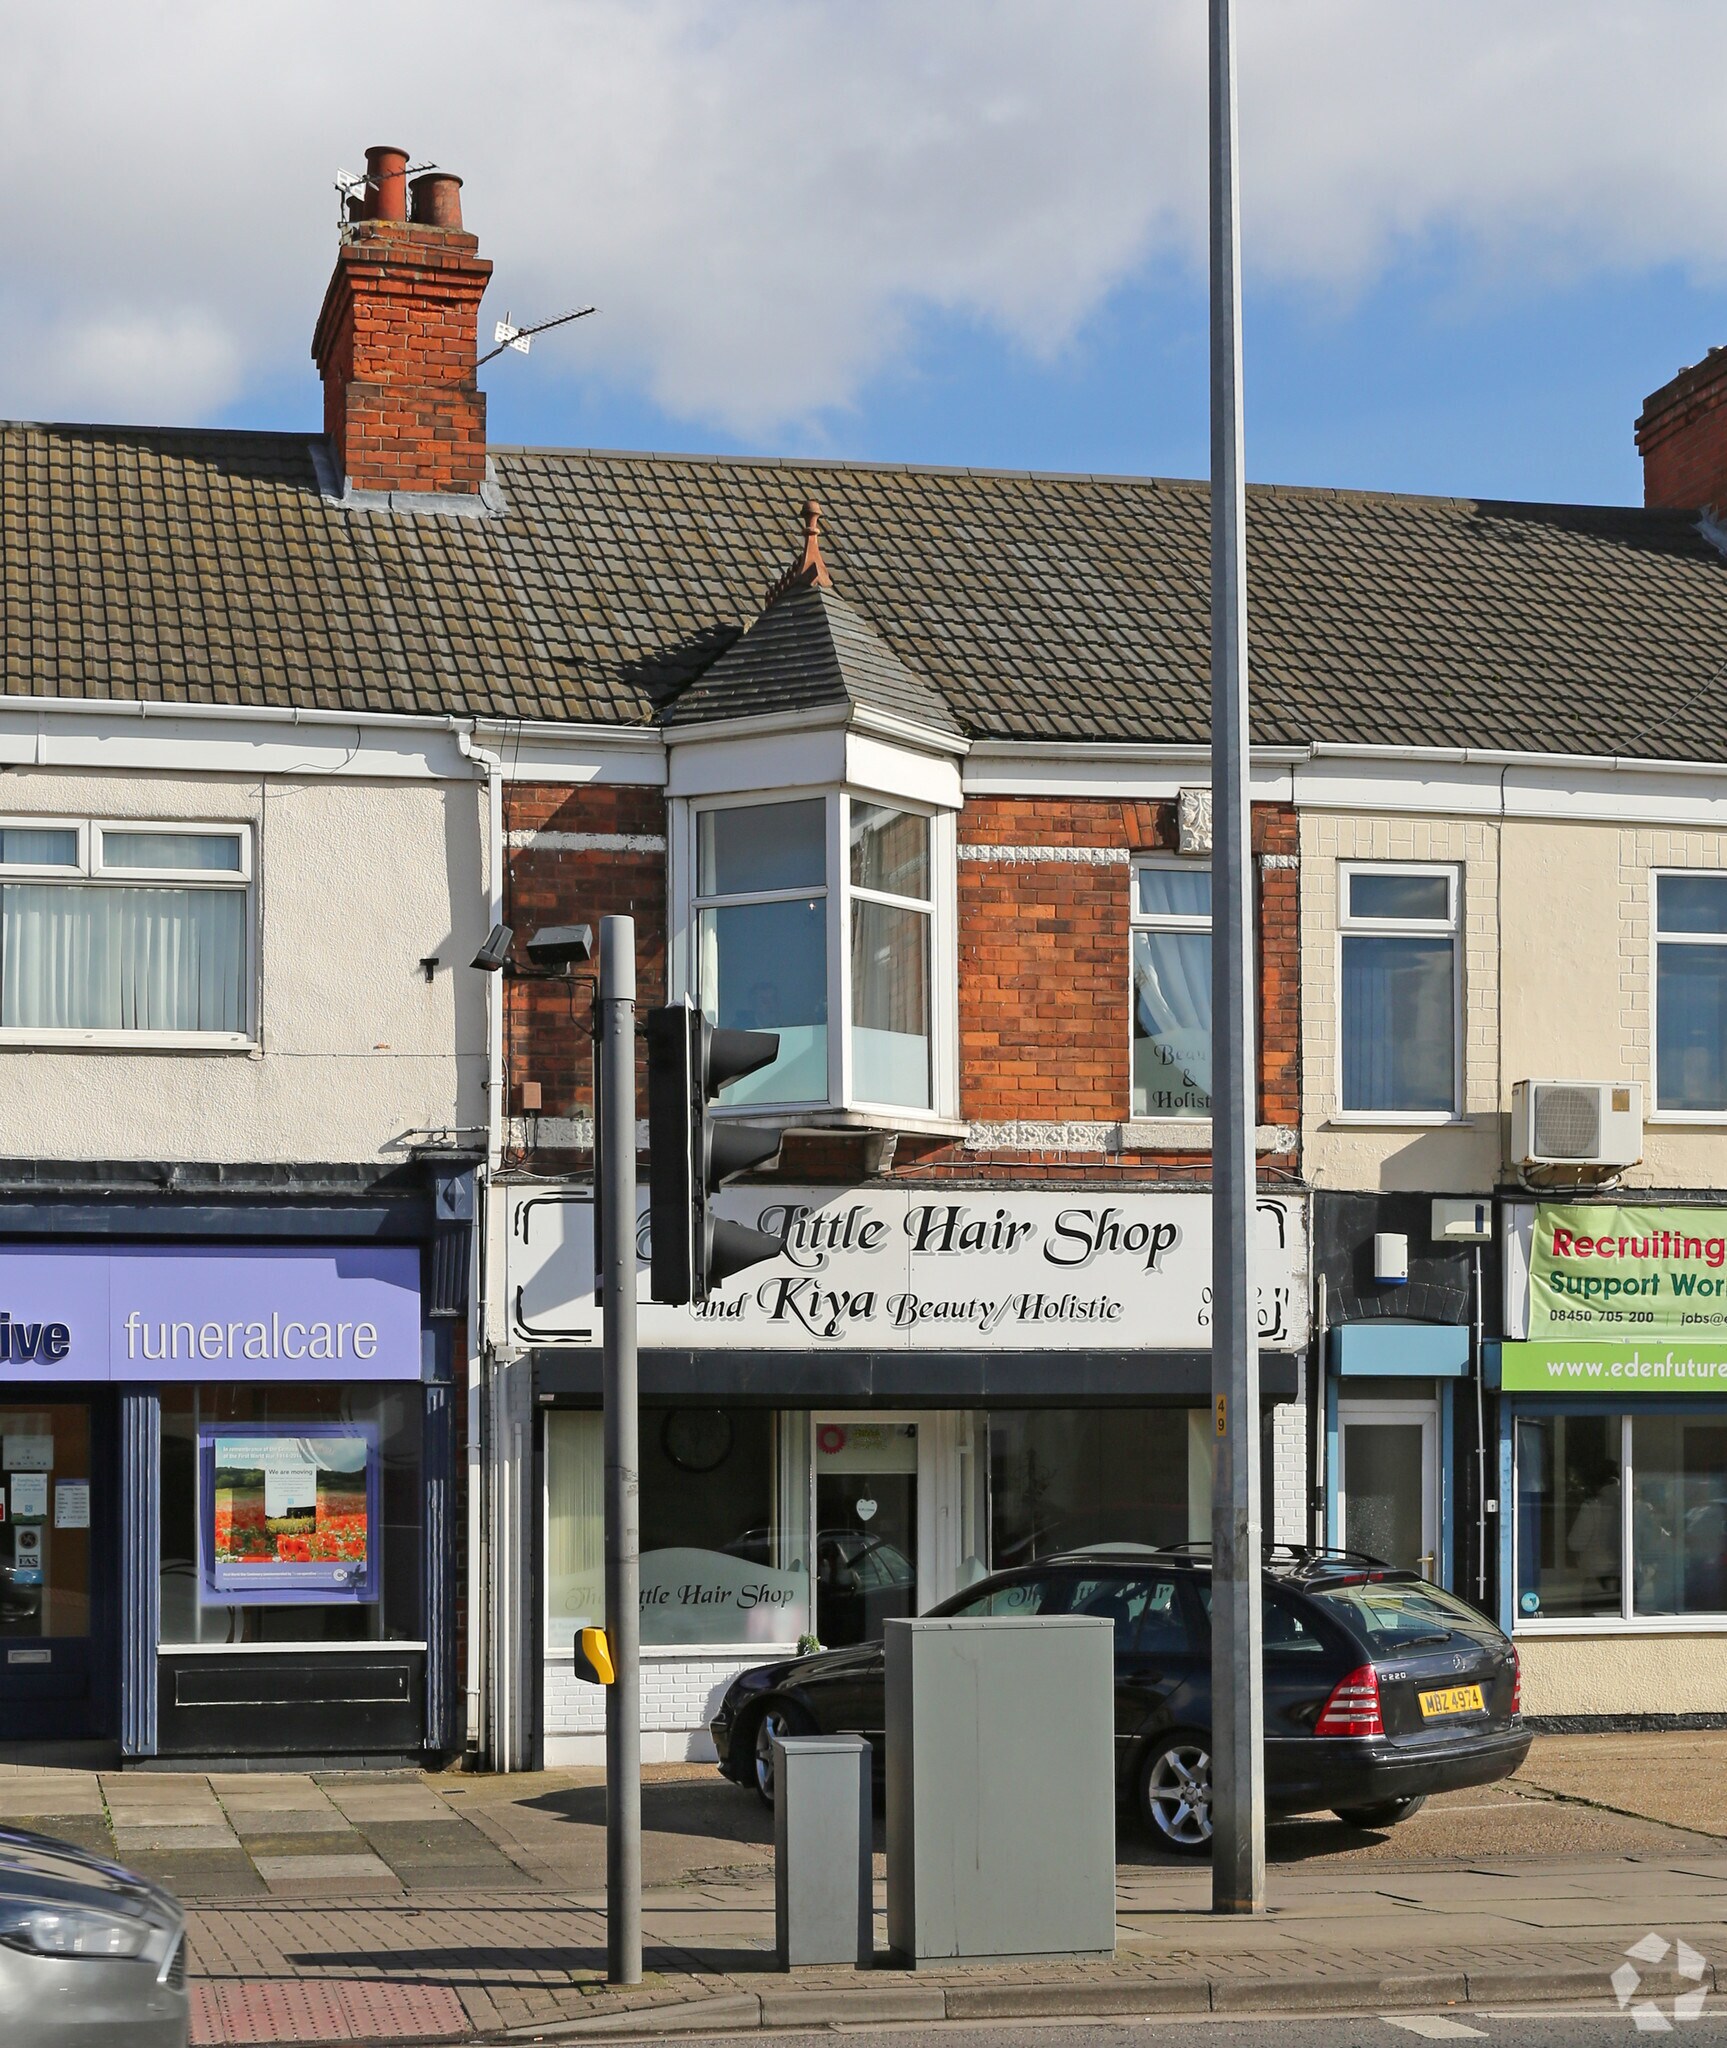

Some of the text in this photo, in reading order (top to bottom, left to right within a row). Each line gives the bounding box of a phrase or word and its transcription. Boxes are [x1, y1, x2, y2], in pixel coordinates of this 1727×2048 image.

[1154, 1044, 1207, 1066] Beau
[1183, 1068, 1198, 1087] &
[1152, 1090, 1211, 1108] Holist
[757, 1204, 888, 1270] Little
[903, 1205, 1035, 1254] Hair
[1043, 1207, 1181, 1273] Shop
[1552, 1228, 1726, 1268] Recruiting
[1550, 1270, 1727, 1300] Support Wor
[696, 1277, 1123, 1338] and Kiya Beauty/Holistic
[1550, 1310, 1654, 1323] 08450 705 200
[123, 1311, 379, 1360] funeralcare
[1547, 1351, 1727, 1378] www.edenfuture
[639, 1585, 670, 1611] ttle
[678, 1584, 732, 1605] Hair
[736, 1583, 794, 1609] Shop
[1451, 1688, 1479, 1710] 4974
